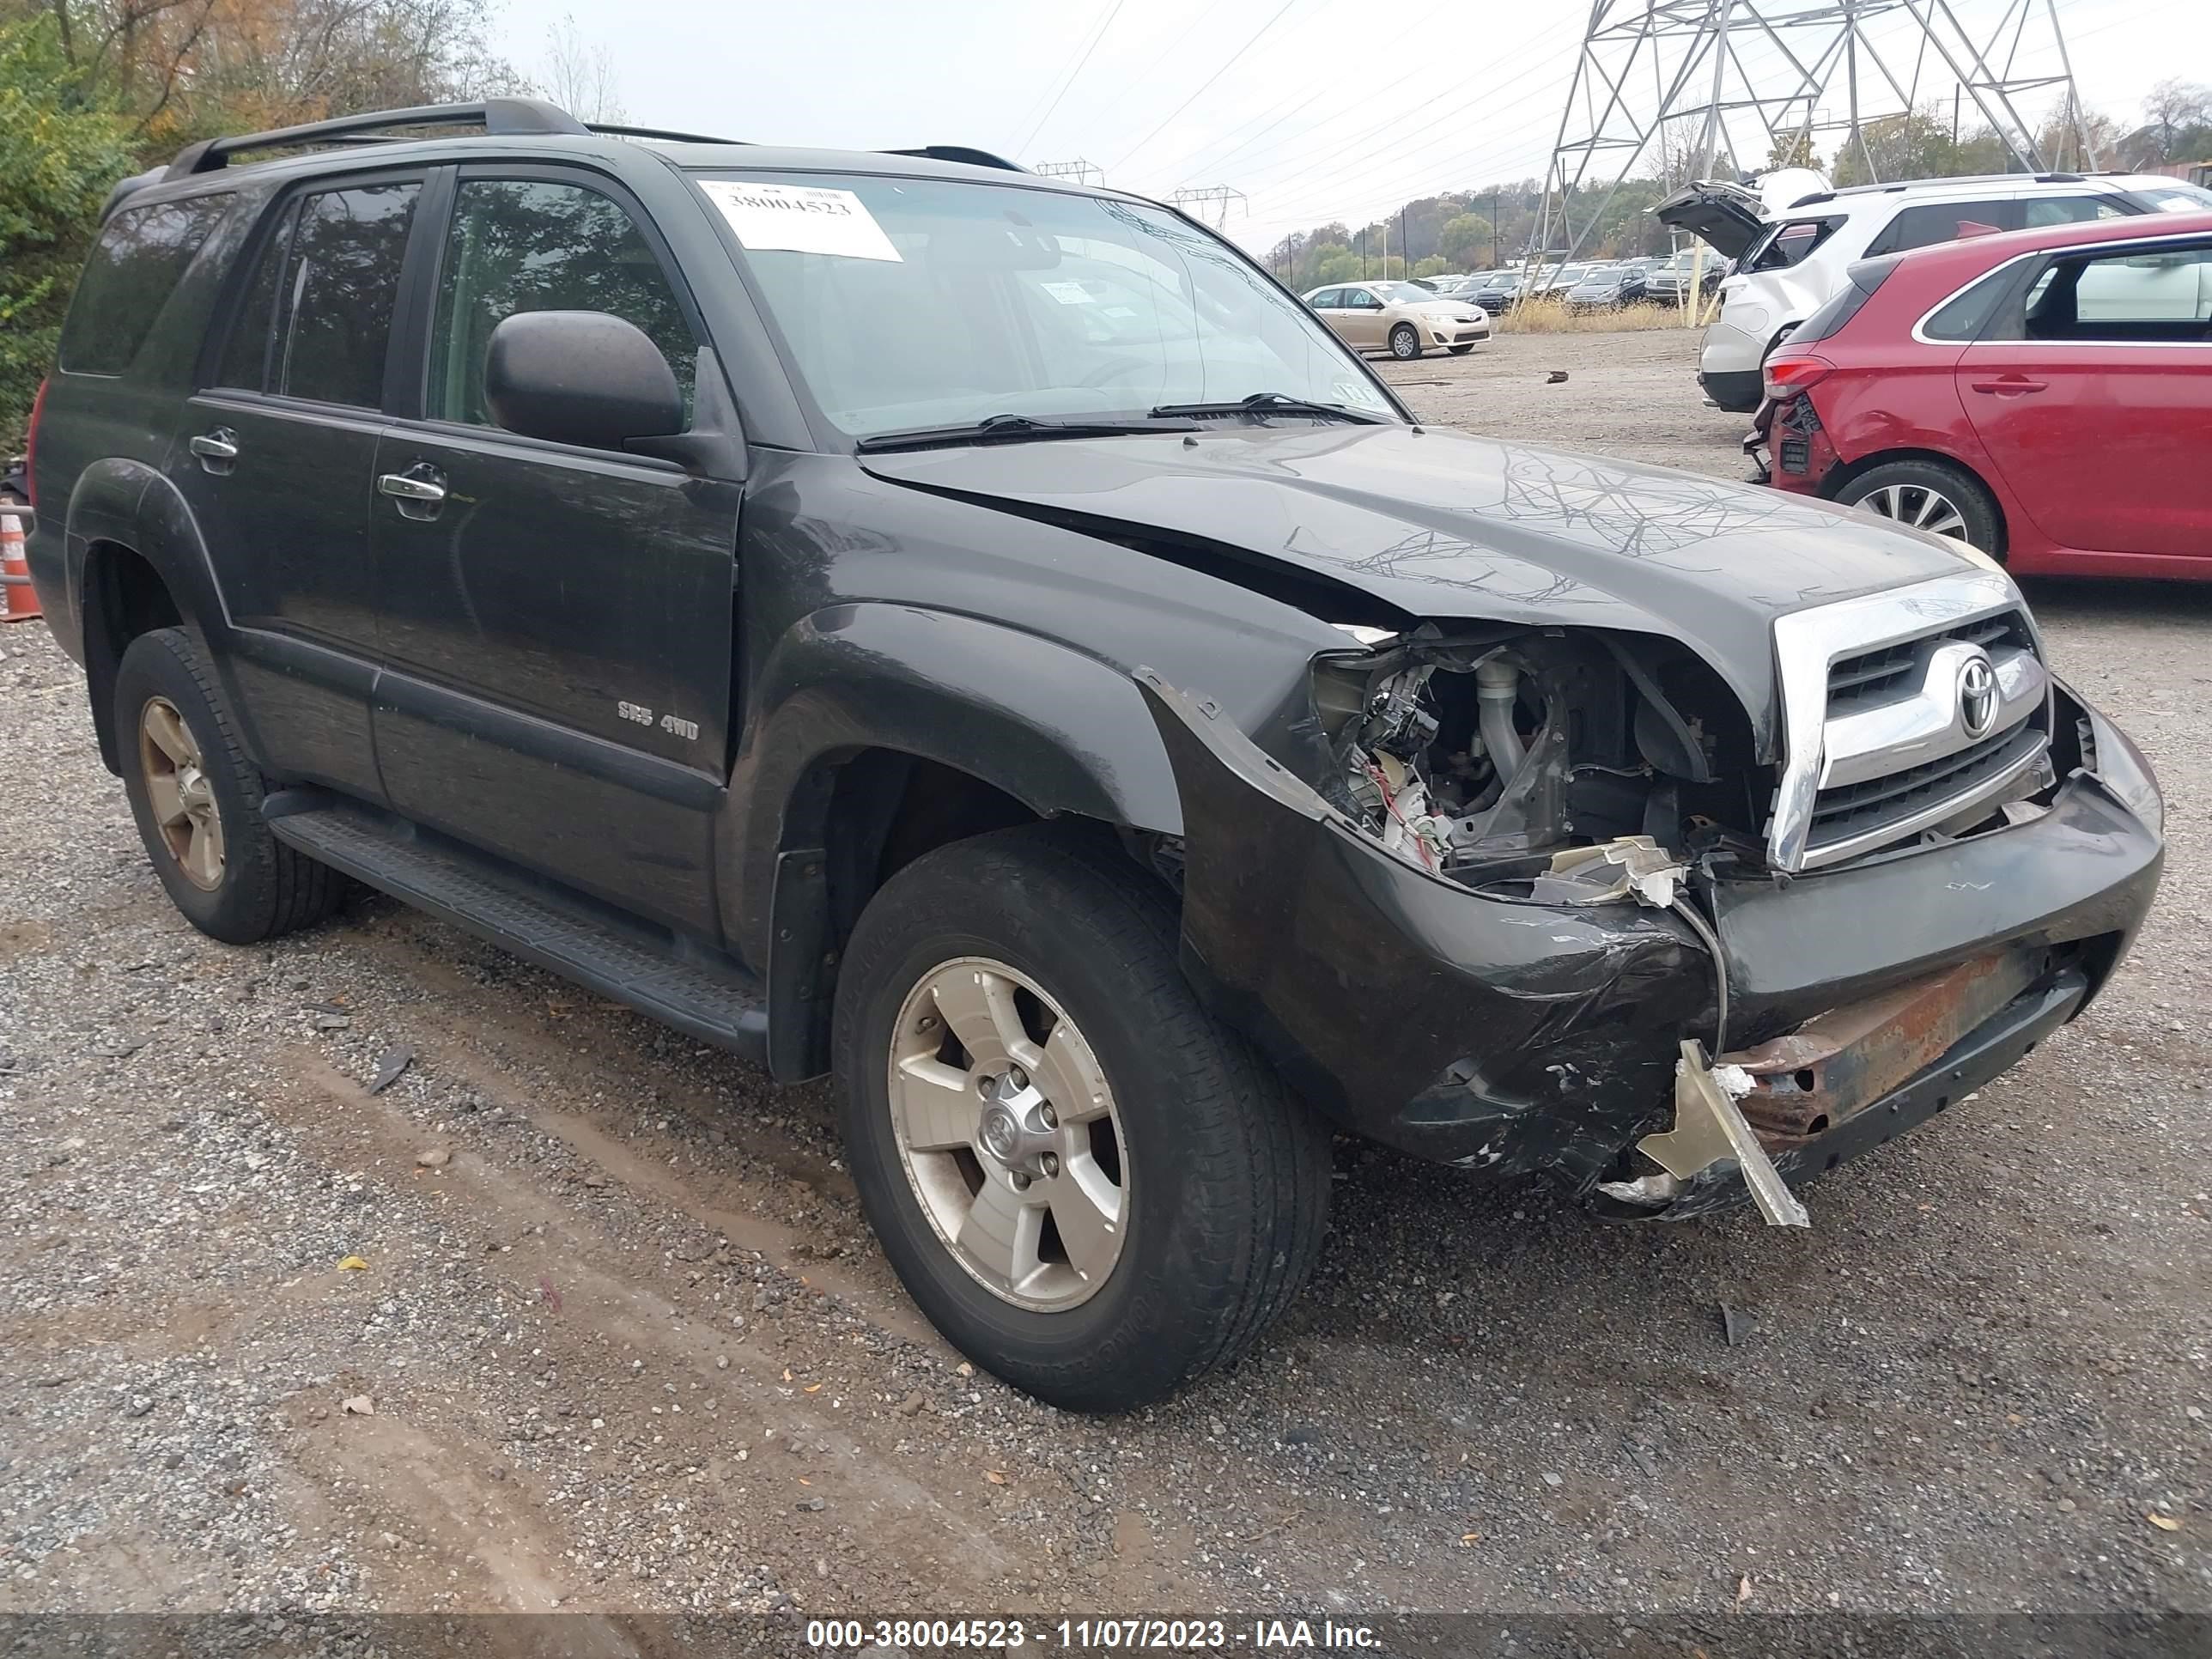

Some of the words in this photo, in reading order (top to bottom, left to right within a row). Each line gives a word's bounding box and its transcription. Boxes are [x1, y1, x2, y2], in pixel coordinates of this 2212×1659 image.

[728, 194, 852, 216] 38004523
[618, 700, 653, 726] SR5
[659, 714, 699, 741] 4WD
